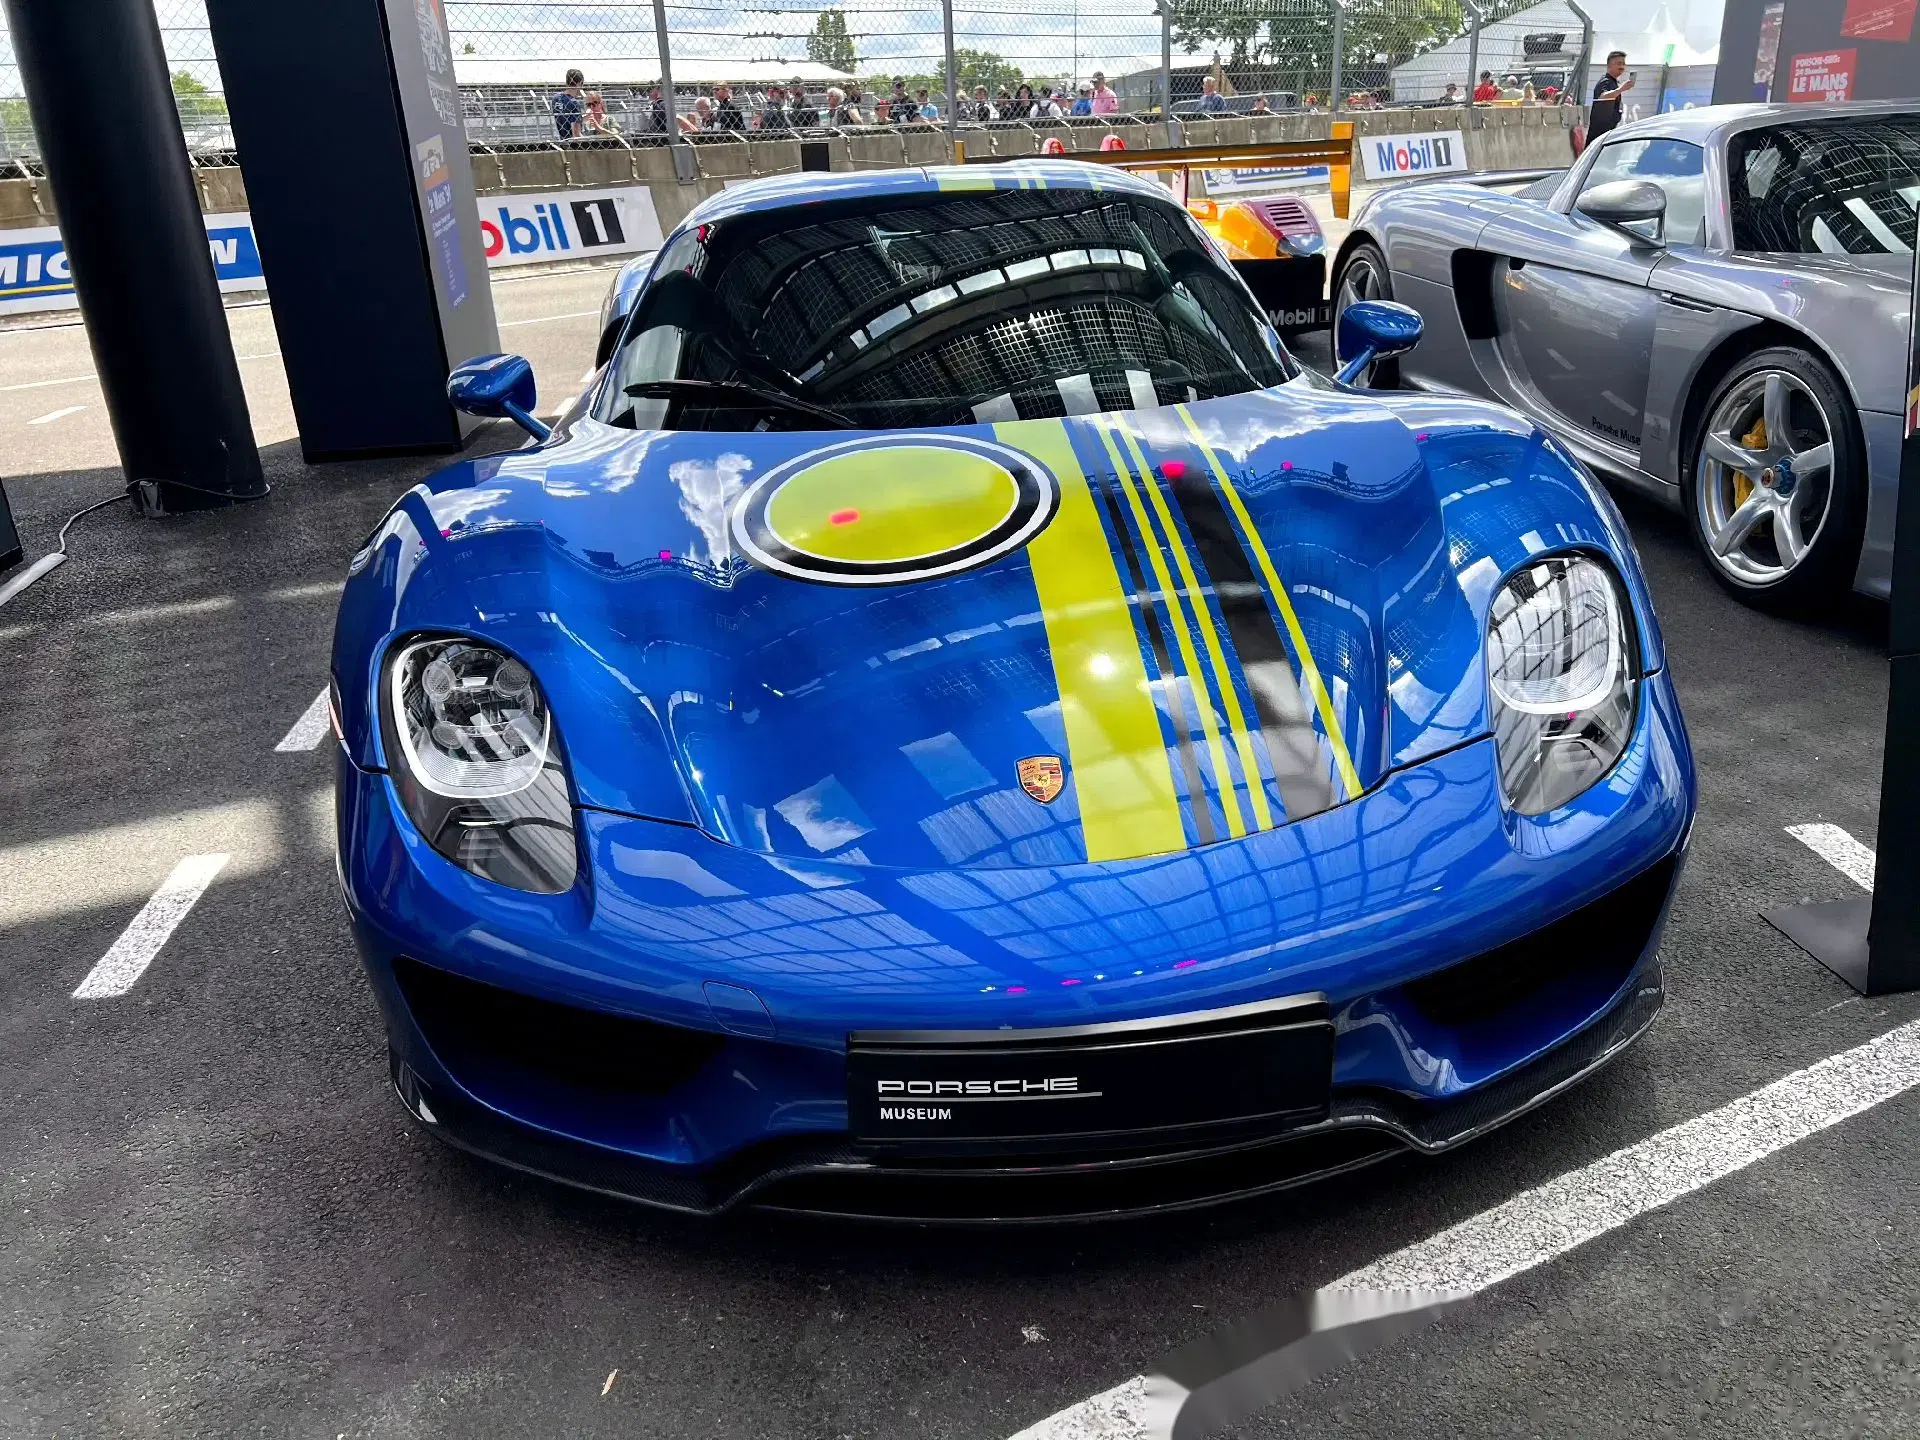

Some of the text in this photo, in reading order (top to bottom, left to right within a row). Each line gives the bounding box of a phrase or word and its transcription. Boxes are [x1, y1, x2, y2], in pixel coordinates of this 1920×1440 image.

[1792, 72, 1848, 92] LE MANS
[1376, 139, 1432, 172] Mobil
[480, 203, 570, 257] obil
[1270, 308, 1315, 327] Mobil
[1592, 416, 1619, 438] Porsche
[878, 1077, 1077, 1094] PORSCHE
[880, 1107, 952, 1120] MUSEUM
